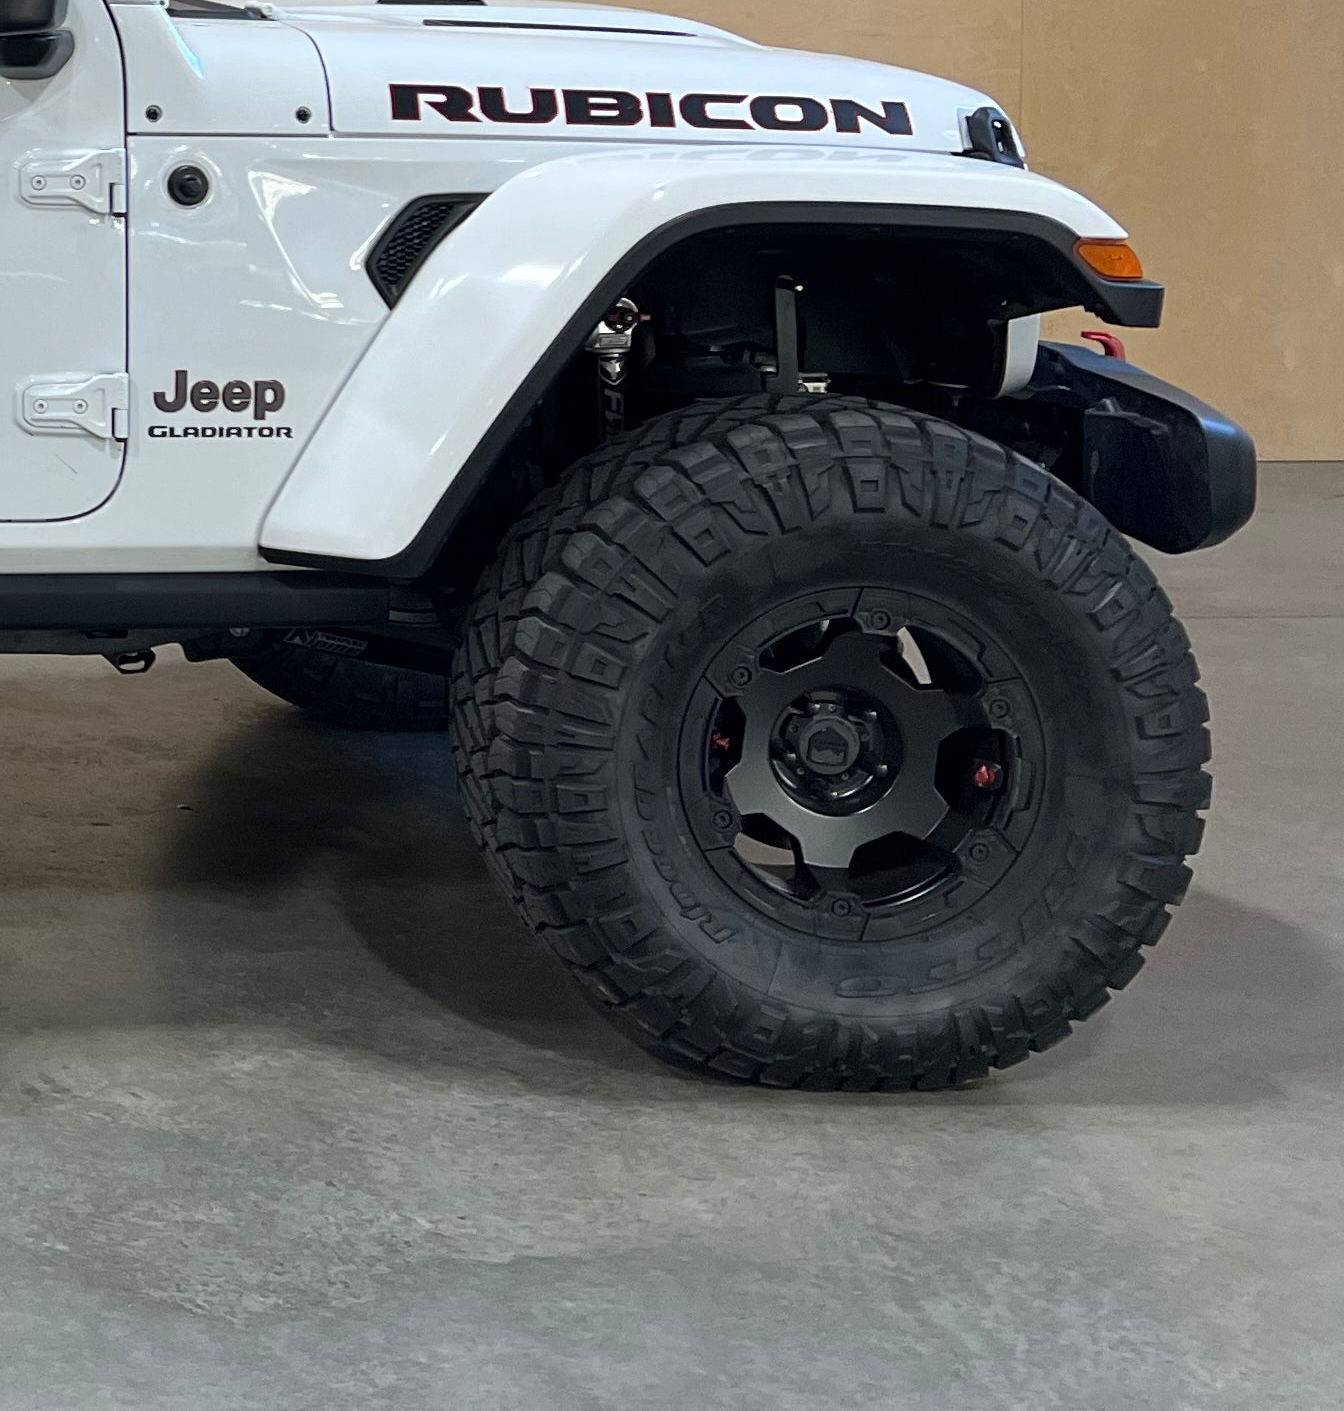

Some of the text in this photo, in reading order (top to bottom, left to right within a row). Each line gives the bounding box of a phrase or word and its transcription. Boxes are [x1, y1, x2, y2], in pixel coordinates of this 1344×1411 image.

[388, 83, 914, 136] RUBICON
[153, 369, 285, 420] Jeep
[148, 425, 294, 439] GLADIATOR
